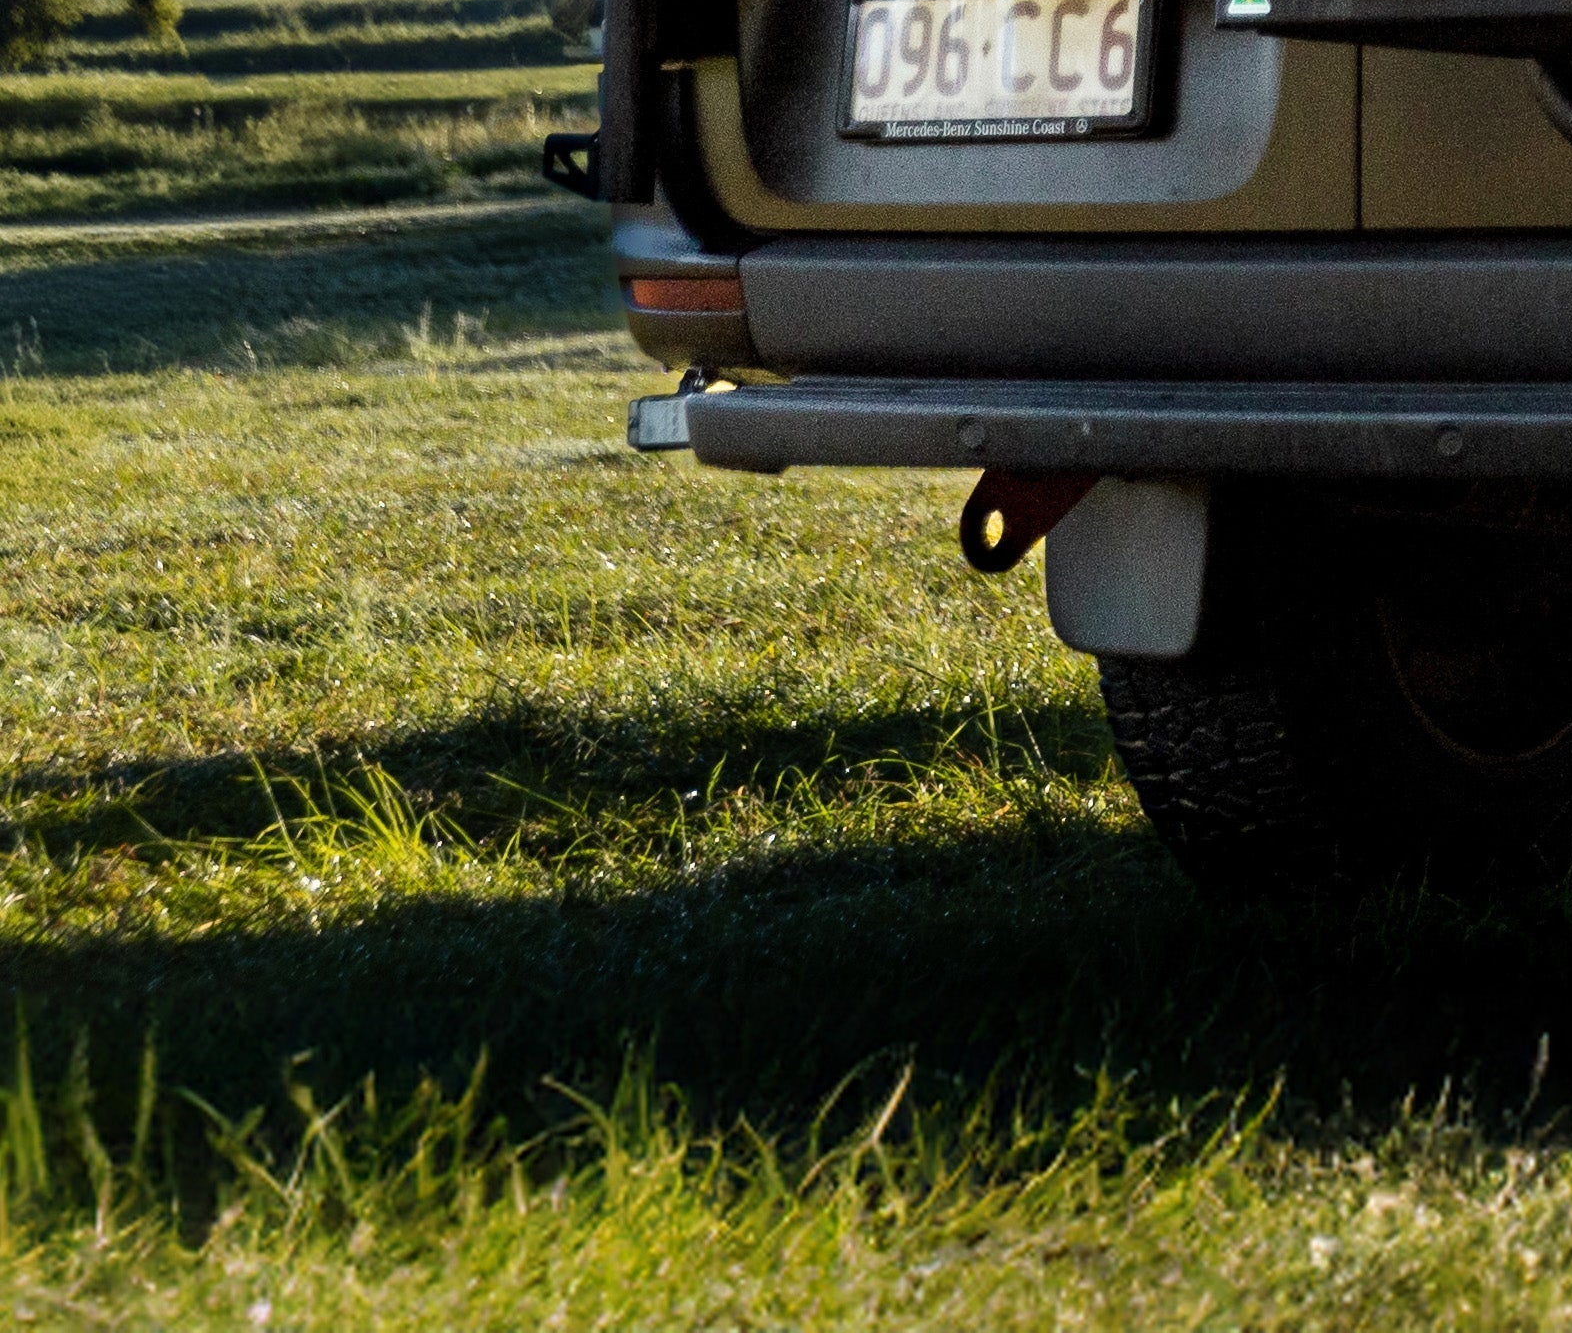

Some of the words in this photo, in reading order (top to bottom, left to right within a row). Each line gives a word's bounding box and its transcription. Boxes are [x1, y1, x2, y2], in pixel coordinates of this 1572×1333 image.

[885, 121, 971, 137] Mercedes-Benz
[975, 119, 1029, 136] Sunshine
[1032, 118, 1066, 134] Coast
